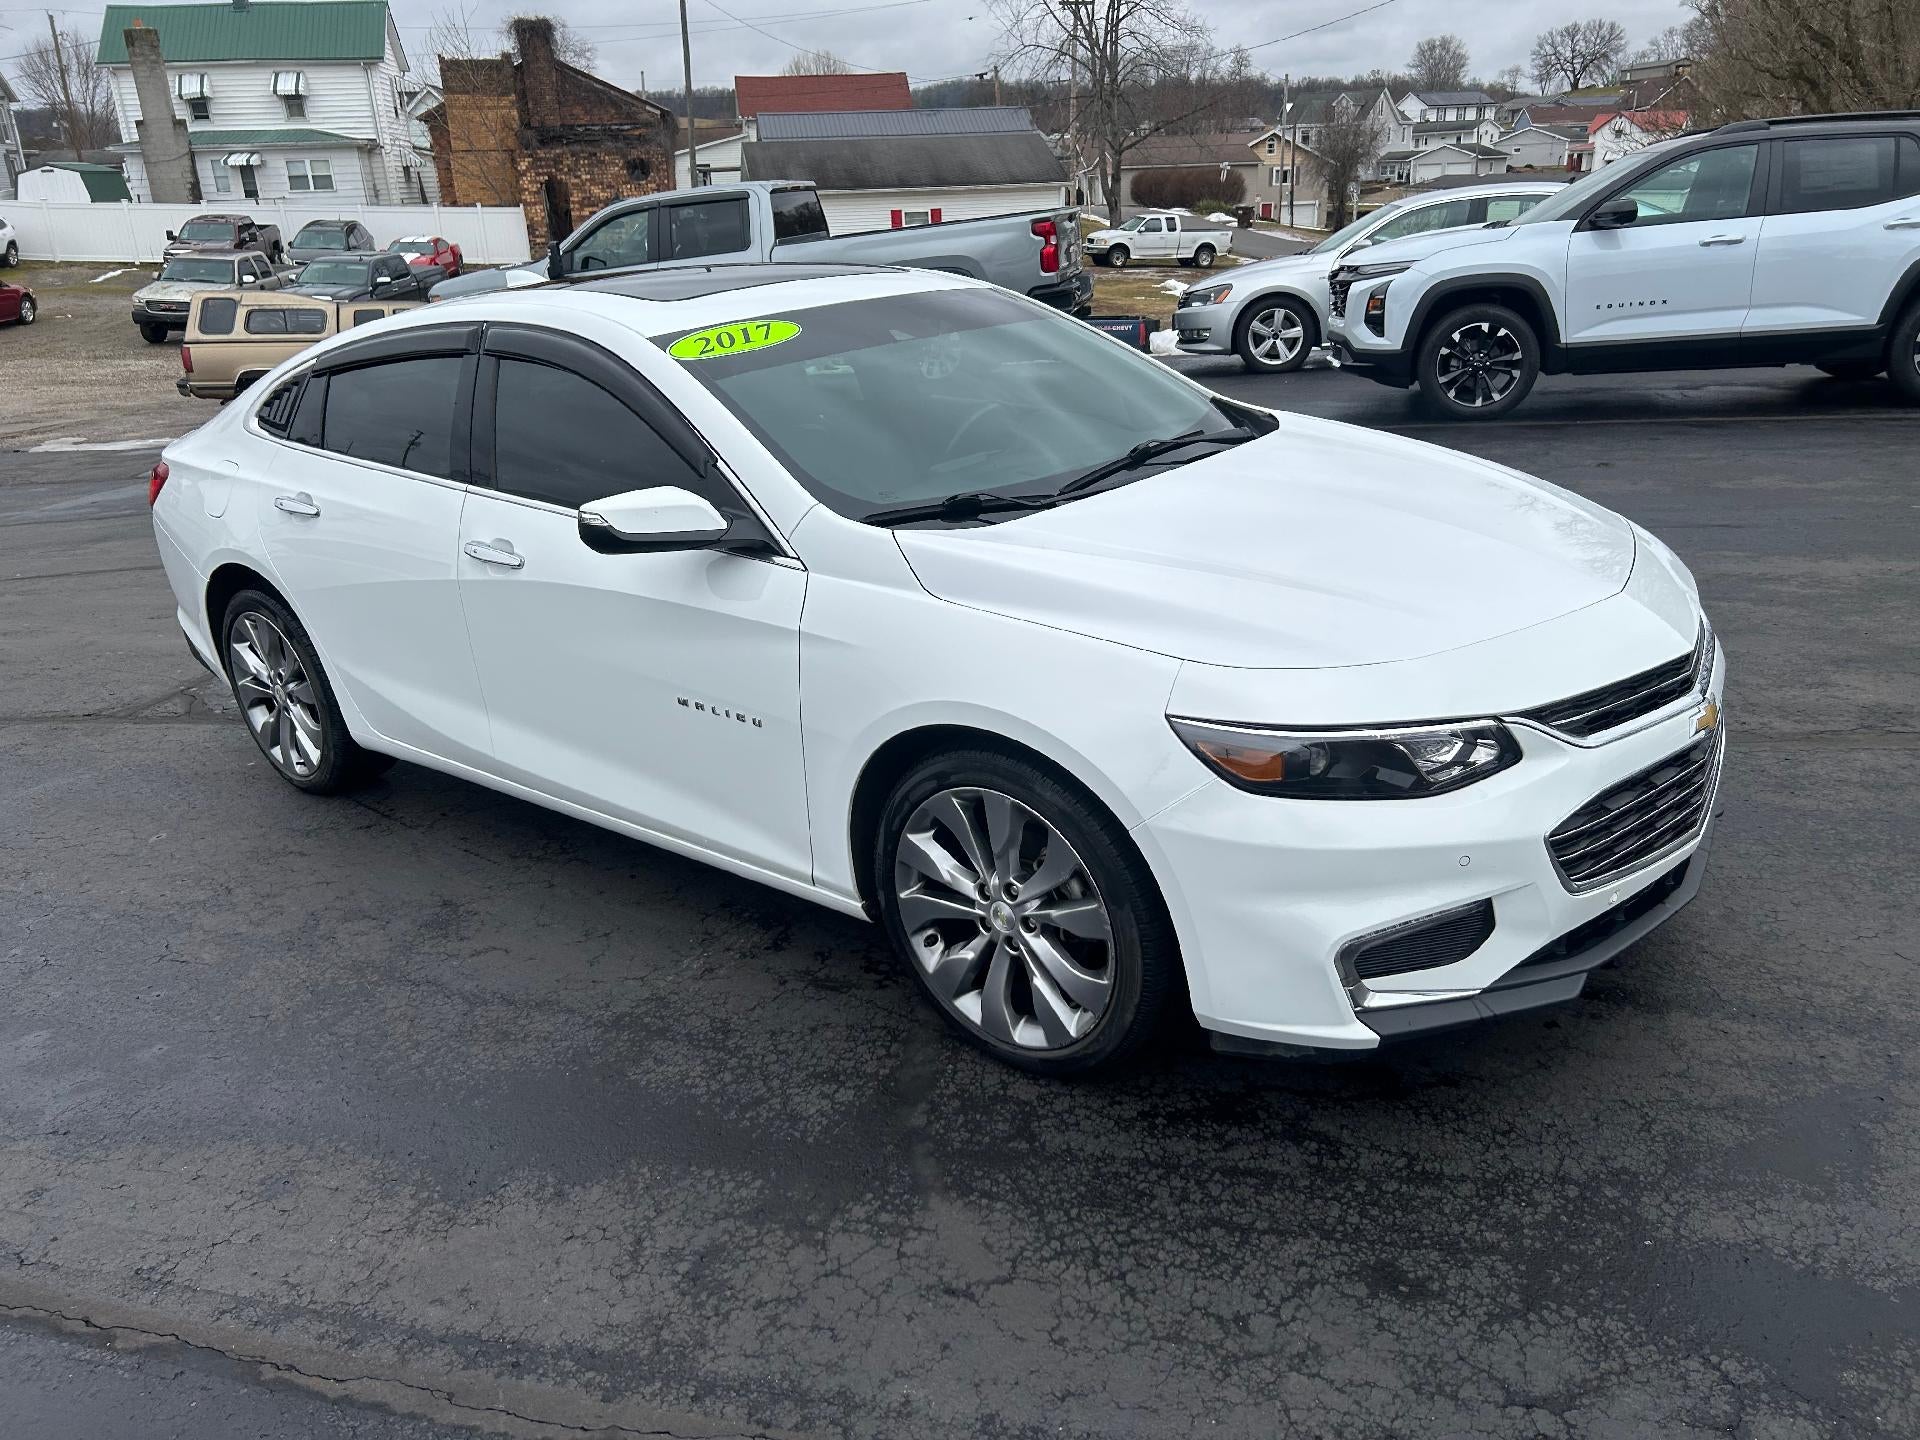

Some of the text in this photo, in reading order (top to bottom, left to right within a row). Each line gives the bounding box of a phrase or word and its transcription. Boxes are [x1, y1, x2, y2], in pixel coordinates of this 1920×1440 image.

[1596, 299, 1668, 310] EQUINOX
[693, 322, 771, 356] 2017
[677, 697, 763, 728] MALIBU
